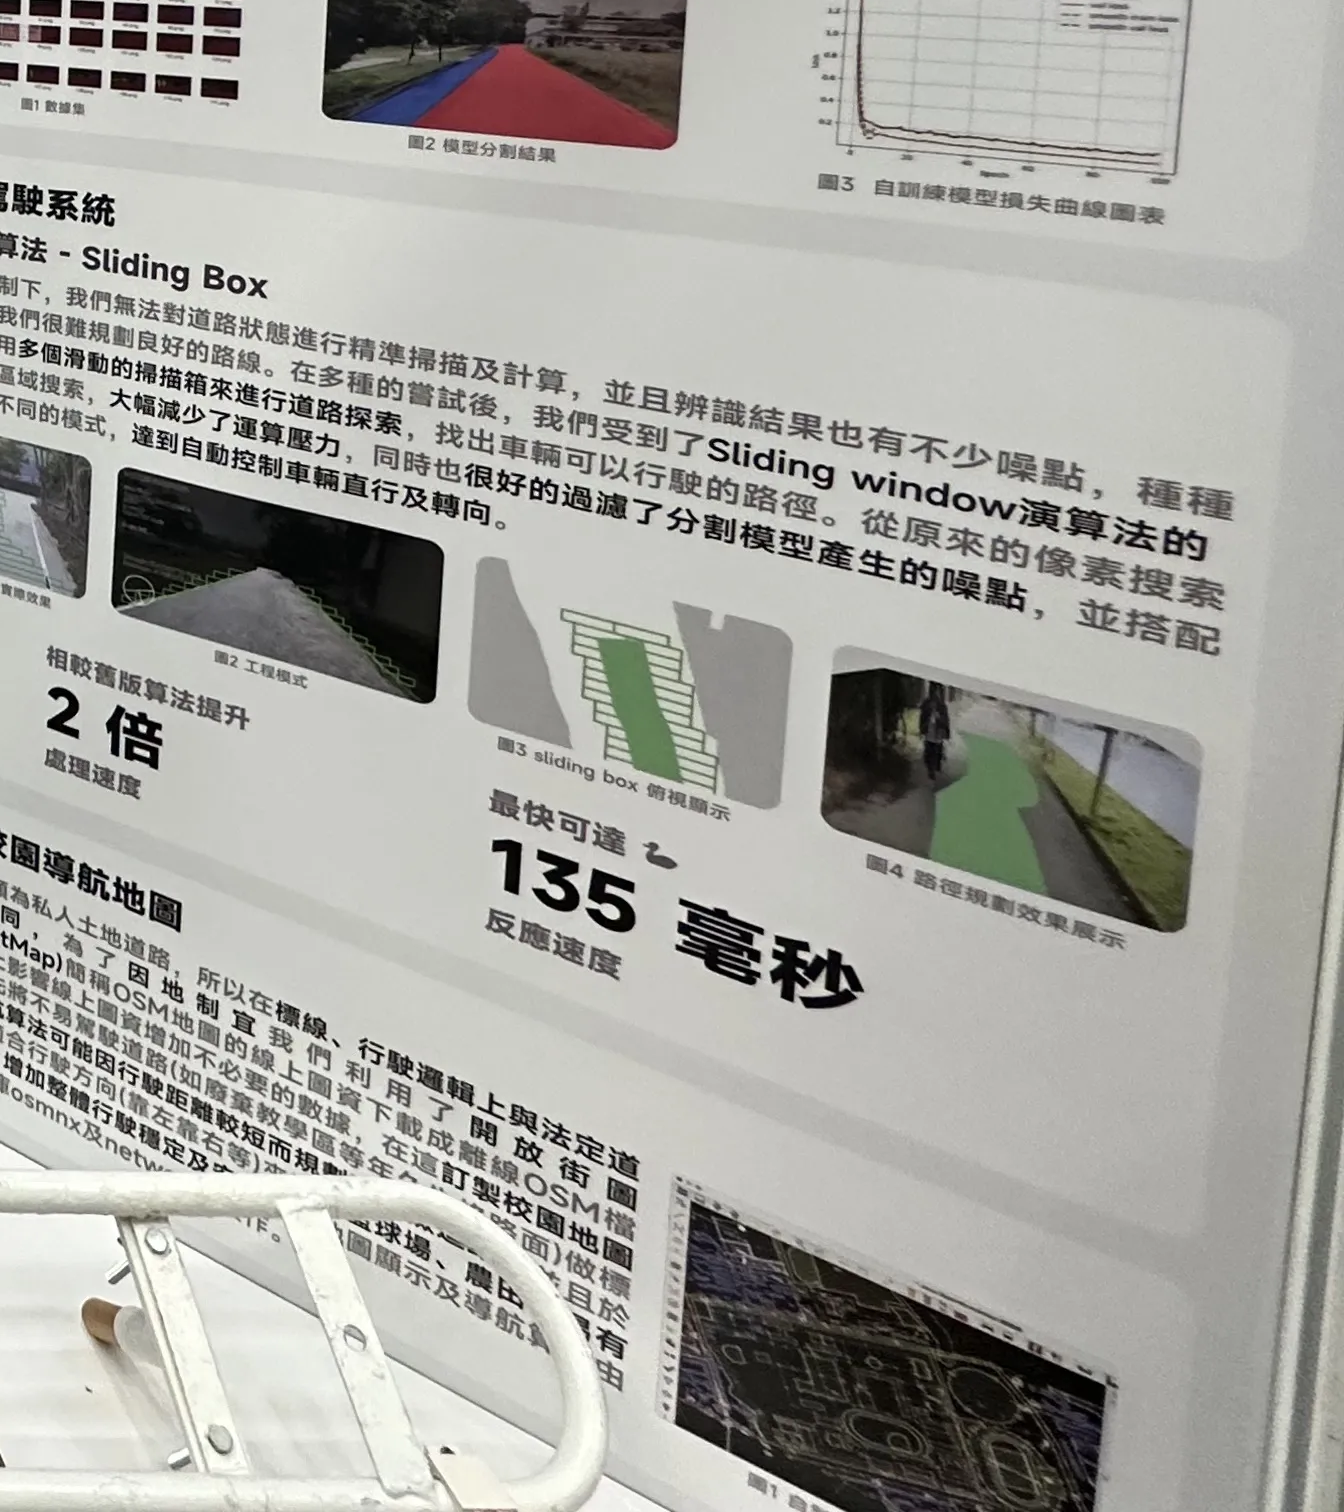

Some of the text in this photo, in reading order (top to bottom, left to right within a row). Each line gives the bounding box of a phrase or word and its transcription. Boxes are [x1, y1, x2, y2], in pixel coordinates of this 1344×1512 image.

[407, 133, 557, 165] 圖2 模型分割結果
[818, 173, 854, 192] 圖3
[82, 246, 190, 290] Sliding
[203, 264, 269, 299] Box
[851, 466, 1209, 561] window演算法的
[46, 645, 250, 730] 相較舊版算法提升
[46, 687, 163, 769] 2 倍
[44, 747, 142, 800] 處理速度
[534, 750, 595, 784] sliding
[603, 769, 639, 792] box
[488, 789, 628, 858] 最快可達
[484, 907, 623, 981] 反應速度
[491, 838, 864, 1010] 135 毫秒
